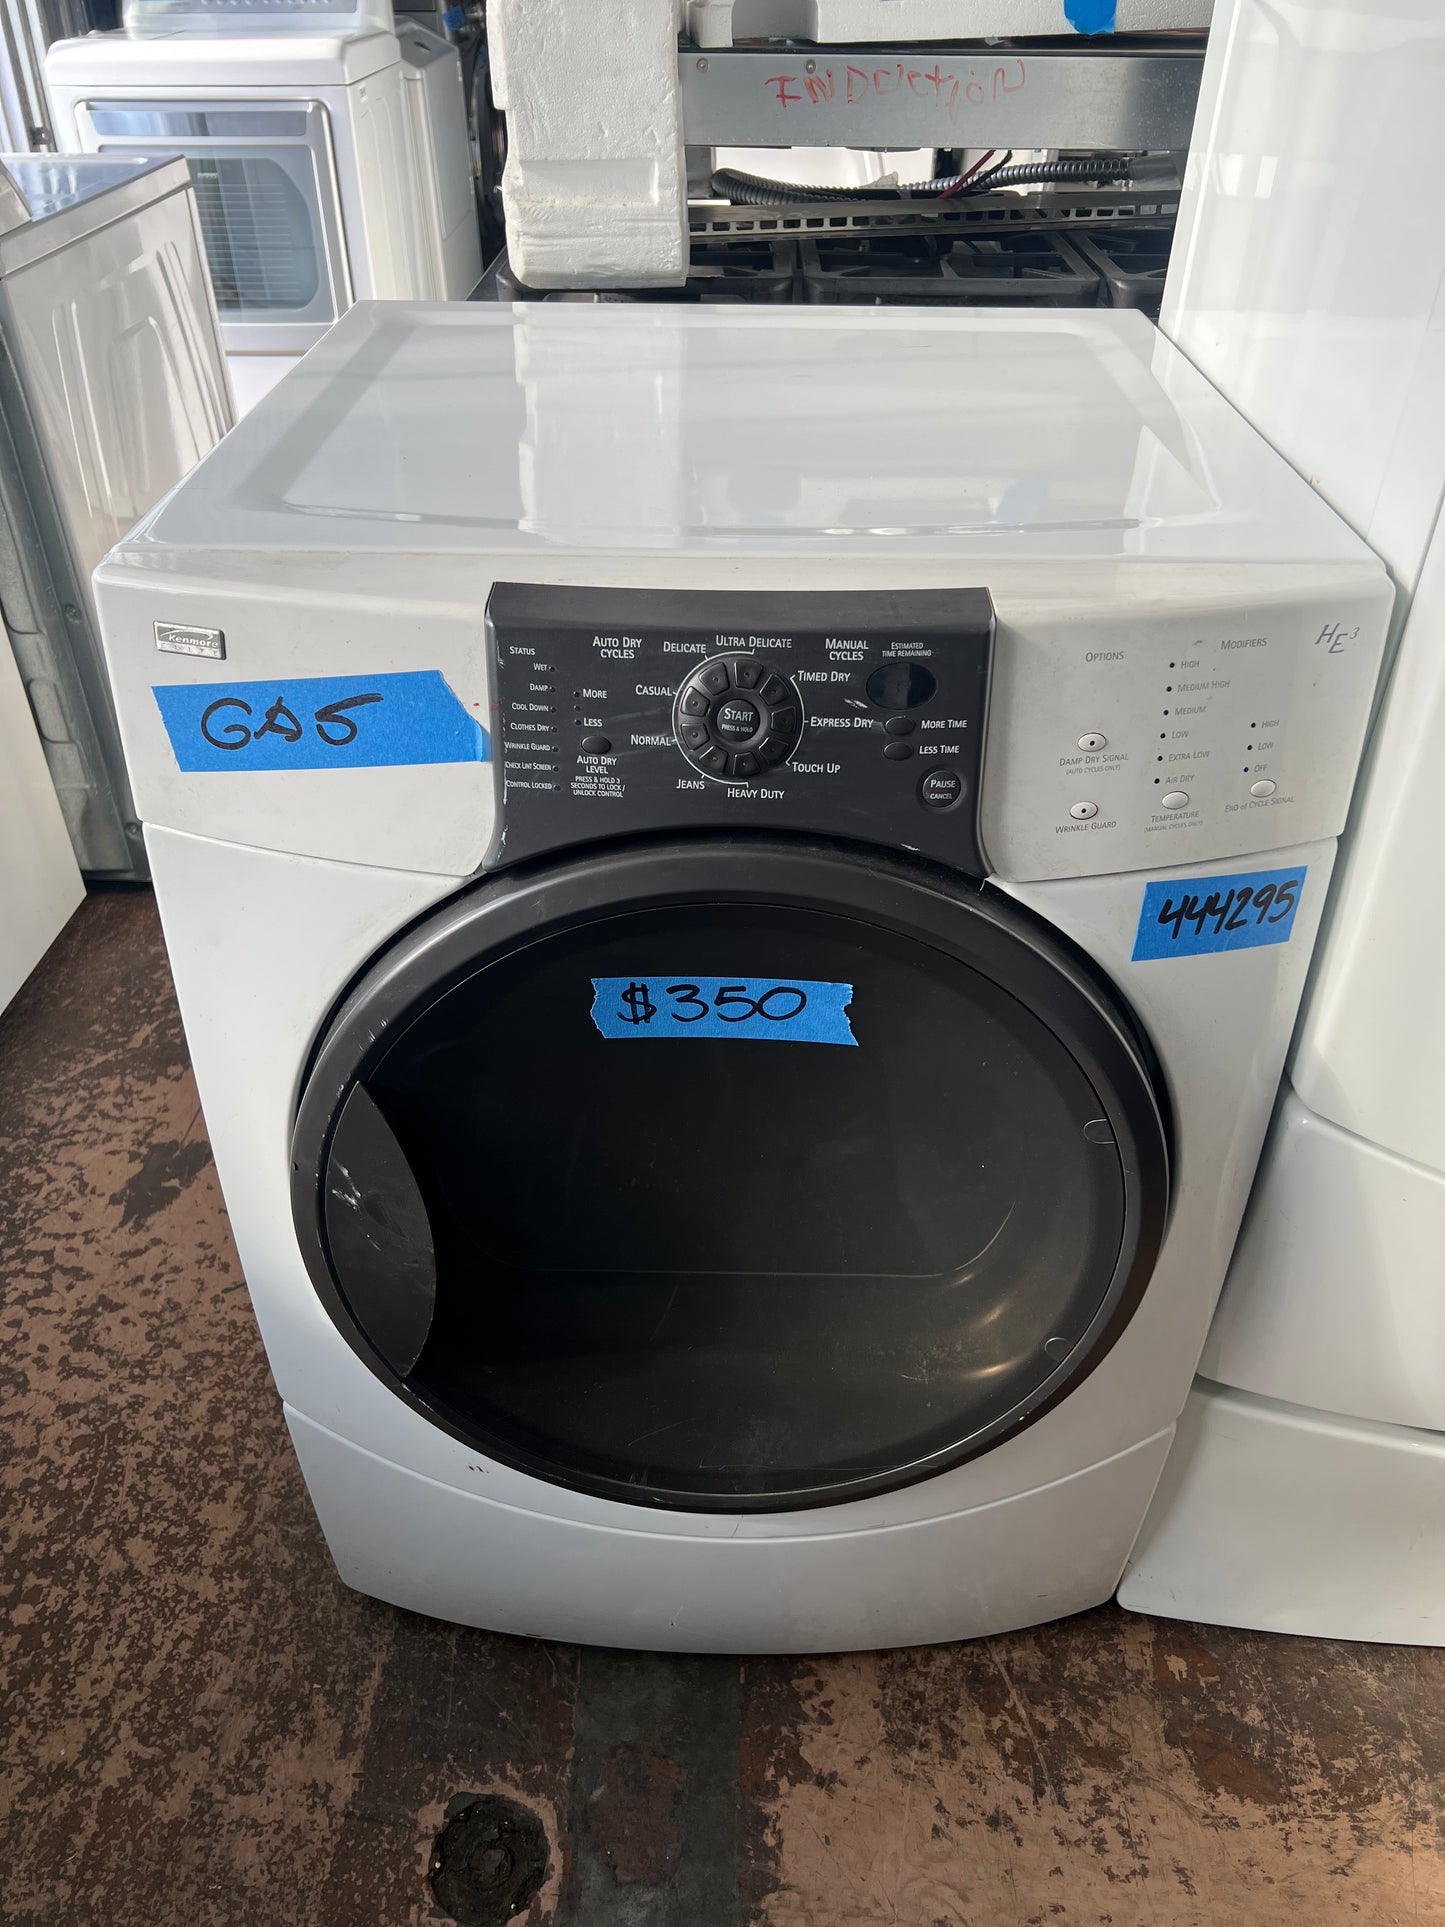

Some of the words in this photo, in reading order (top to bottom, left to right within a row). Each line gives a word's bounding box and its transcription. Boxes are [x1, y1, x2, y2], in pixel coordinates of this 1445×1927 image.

[168, 634, 218, 648] Kenmore
[592, 636, 619, 647] AUTO
[622, 637, 642, 648] DRY
[715, 635, 745, 647] ULTRA
[749, 636, 792, 649] DELICATE
[825, 638, 869, 650] MANUAL
[891, 642, 924, 650] ESTIMATED
[1220, 638, 1268, 650] MODIFIERS
[509, 646, 536, 656] STATUS
[663, 641, 707, 653] DELICATE
[600, 649, 635, 659] CYCLES
[829, 651, 864, 661] CYCLES
[1085, 651, 1124, 663] OPTIONS
[533, 663, 547, 672] WET
[1180, 660, 1200, 669] HIGH
[797, 670, 828, 682] TIMED
[830, 671, 851, 682] DRY
[529, 683, 548, 692] DAMP
[635, 684, 672, 697] CASUAL
[1177, 682, 1209, 692] MEDIUM
[1211, 680, 1231, 689] HIGH
[582, 689, 607, 699] MORE
[511, 702, 528, 710] COOL
[529, 703, 549, 712] DOWN
[1174, 706, 1206, 716] MEDIUM
[724, 707, 754, 722] START
[510, 722, 536, 731] CLOTHES
[537, 723, 550, 732] DRY
[583, 718, 603, 727] LESS
[810, 716, 851, 727] EXPRESS
[854, 717, 874, 728] DRY
[921, 719, 946, 729] MORE
[947, 719, 967, 728] TIME
[1261, 720, 1280, 728] HIGH
[721, 723, 735, 732] PRESS
[740, 725, 753, 733] HOLD
[1171, 730, 1189, 739] LOW
[630, 734, 671, 746] NORMAL
[504, 742, 530, 750] WRINKLE
[530, 743, 550, 751] GUARD
[919, 746, 938, 754] LESS
[940, 745, 960, 754] TIME
[1257, 742, 1274, 750] LOW
[577, 755, 599, 765] AUTO
[601, 756, 617, 766] DRY
[1059, 757, 1083, 766] DAMP
[1084, 755, 1100, 764] DRY
[1102, 753, 1129, 763] SIGNAL
[1168, 752, 1191, 762] EXTRA
[1193, 751, 1210, 759] LOW
[505, 761, 521, 769] CHECK
[533, 762, 551, 770] SCREEN
[586, 766, 608, 775] LEVEL
[792, 762, 824, 773] TOUCH
[827, 762, 841, 773] UP
[1254, 764, 1268, 772] OFF
[676, 779, 705, 790] JEANS
[930, 779, 956, 788] PAUSE
[1165, 776, 1178, 785] AIR
[1179, 774, 1195, 783] DRY
[506, 780, 531, 788] CONTROL
[531, 782, 552, 790] LOCKED
[727, 787, 758, 799] HEAVY
[760, 788, 785, 799] DUTY
[1150, 811, 1200, 823] TEMPERATURE
[1055, 823, 1089, 834] WRINKLE
[1091, 821, 1117, 830] GUARD
[1158, 879, 1299, 940] 444295
[616, 981, 807, 1025] $350
